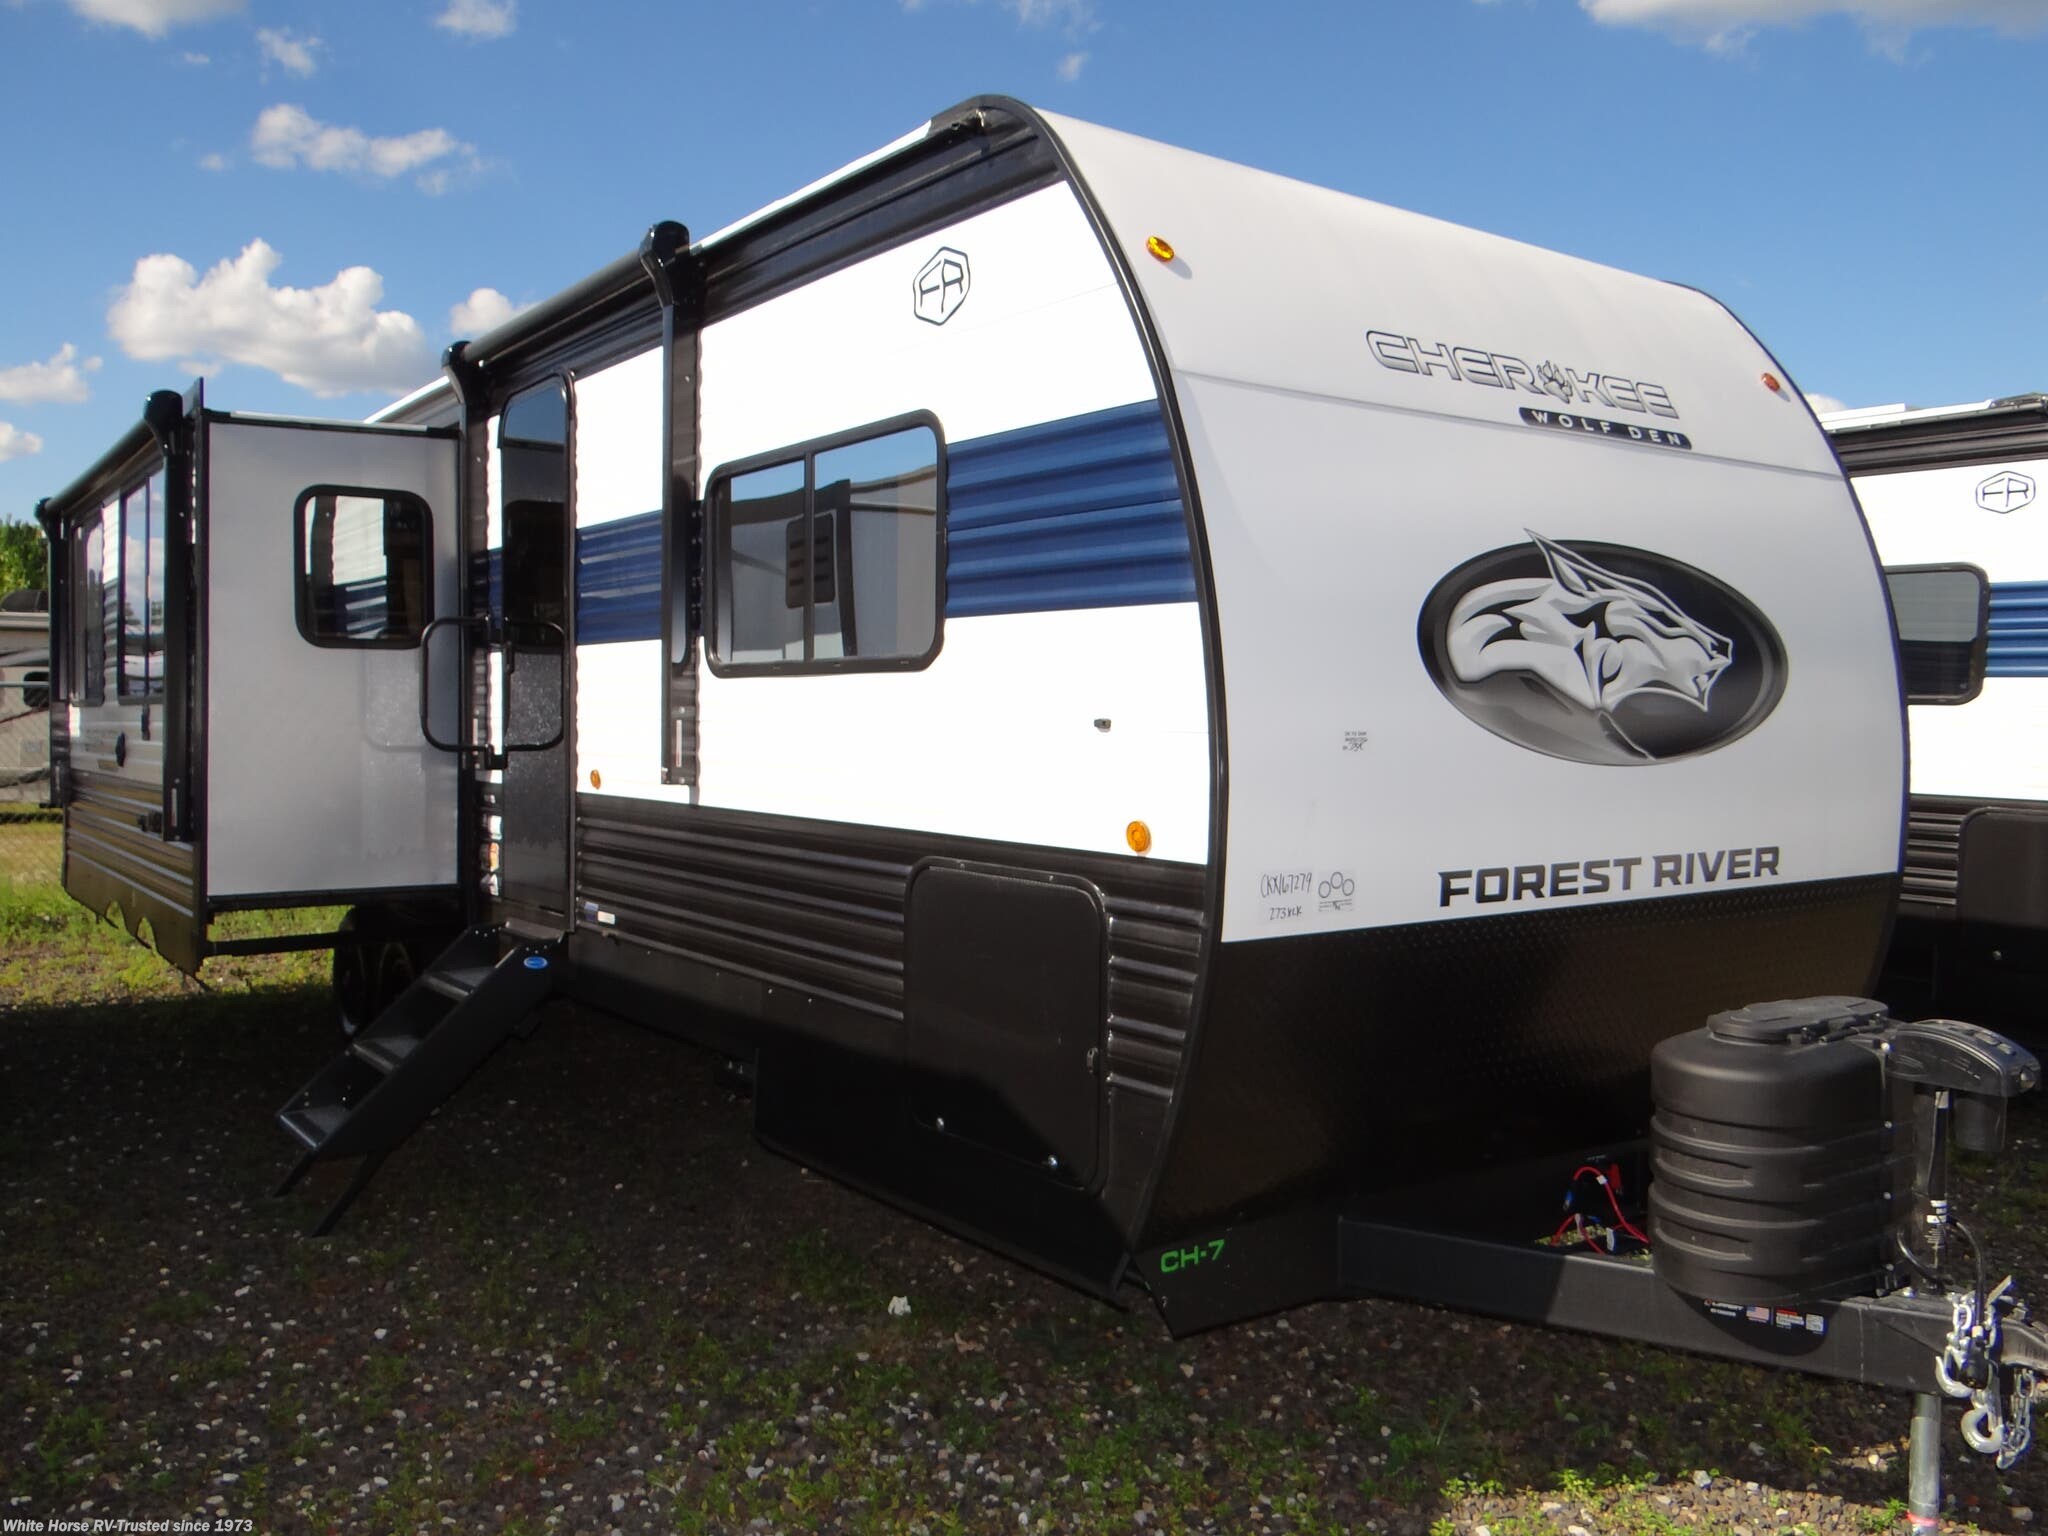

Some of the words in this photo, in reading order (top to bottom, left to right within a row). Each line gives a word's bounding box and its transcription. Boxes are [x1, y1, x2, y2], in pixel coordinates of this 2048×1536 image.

[1531, 410, 1612, 434] WOLF
[1627, 425, 1681, 447] DEN
[1437, 856, 1643, 908] FOREST
[1652, 845, 1780, 888] RIVER
[1160, 1239, 1225, 1273] CH-7
